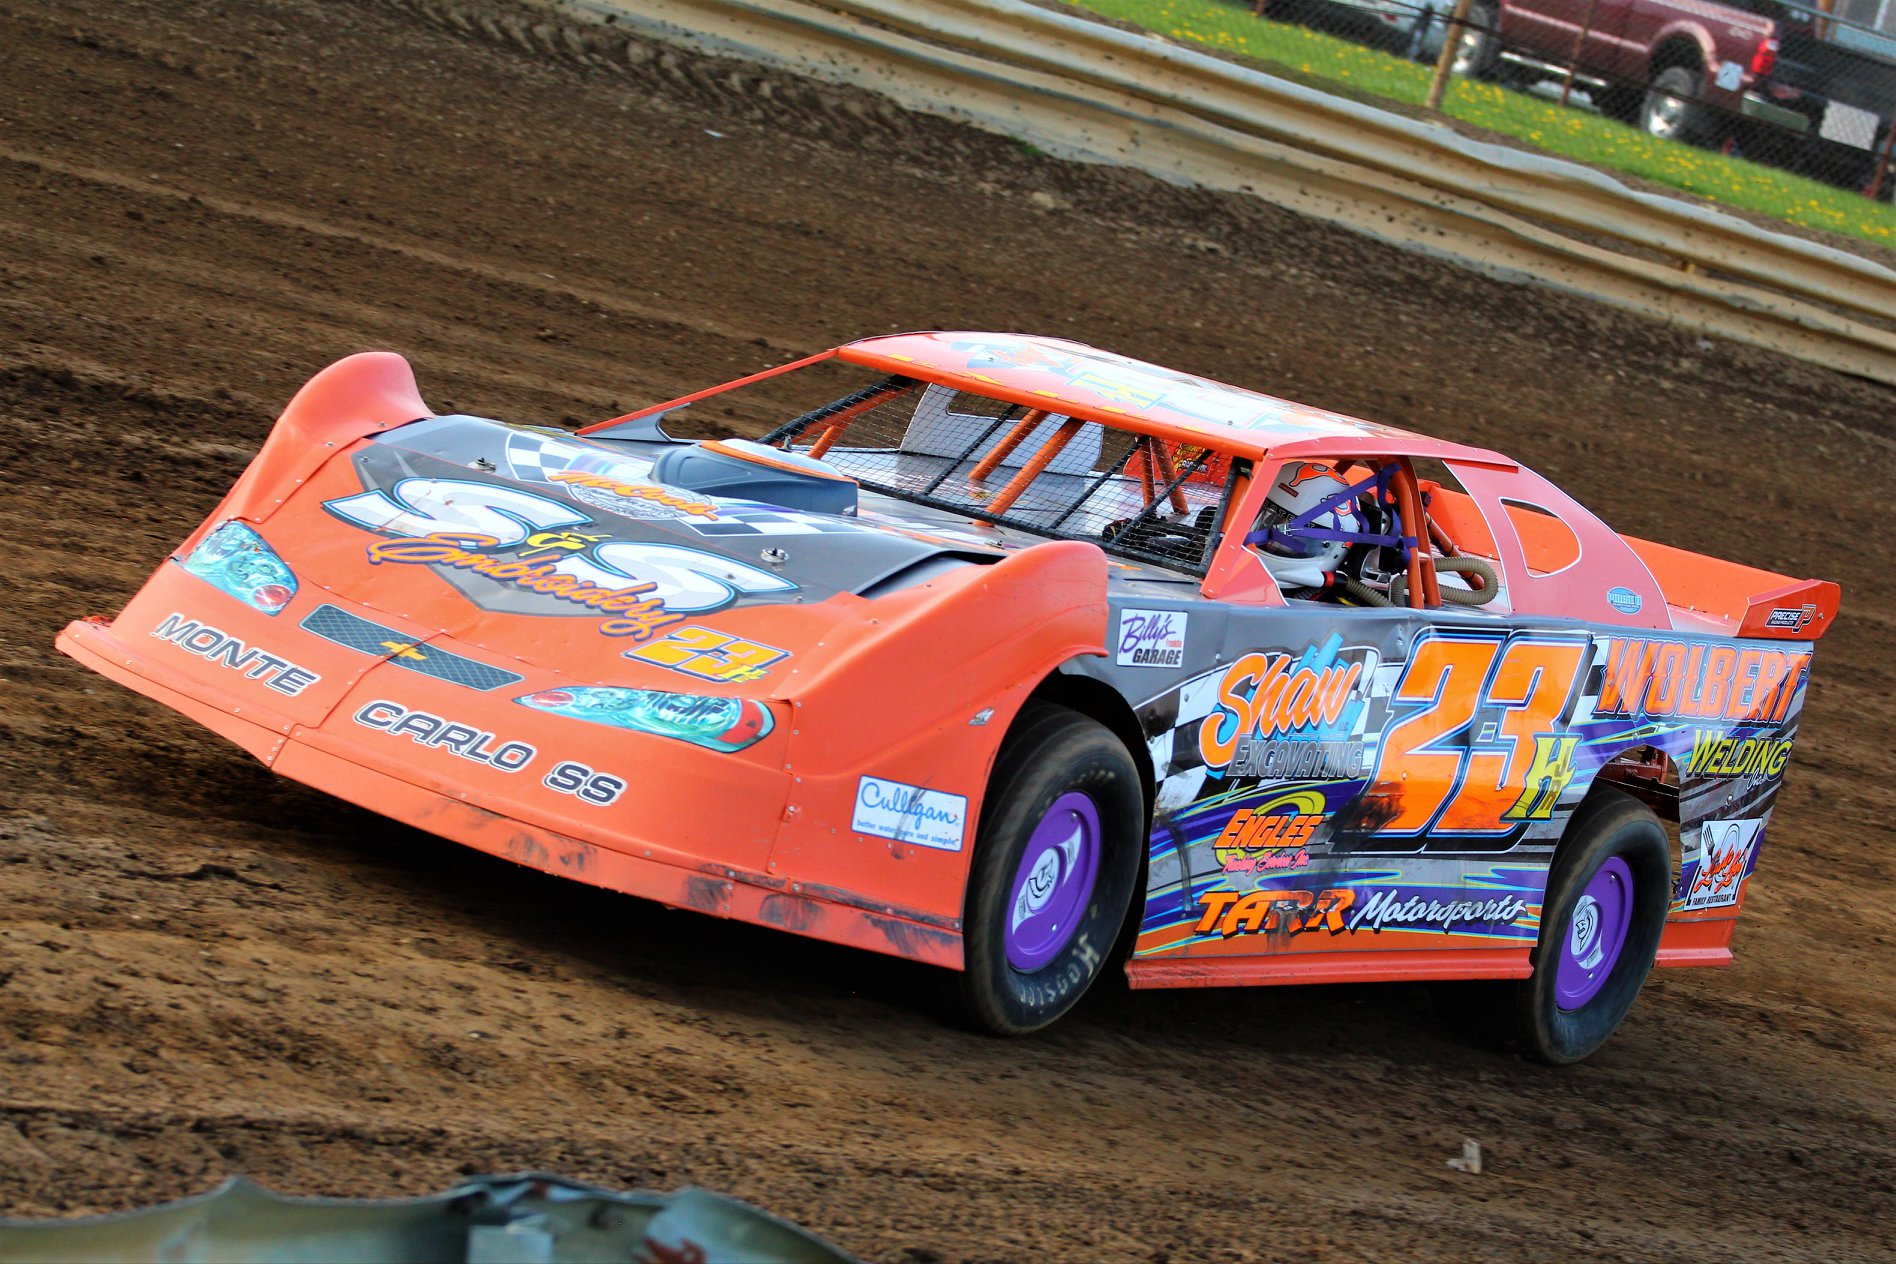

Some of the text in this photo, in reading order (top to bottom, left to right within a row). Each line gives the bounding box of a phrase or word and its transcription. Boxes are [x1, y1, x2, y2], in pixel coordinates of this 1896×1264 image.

[321, 477, 594, 550] S
[366, 532, 685, 641] Embroidery
[1119, 613, 1176, 654] Billy's
[1770, 611, 1801, 621] PRECISE
[150, 612, 322, 697] MONTE
[1132, 648, 1182, 665] GARAGE
[1593, 634, 1813, 726] WOLBERT
[1199, 652, 1362, 768] Shaw
[352, 700, 628, 806] CARLO SS
[1226, 734, 1364, 778] EXCAVATING
[1686, 730, 1794, 778] WELDING
[861, 782, 957, 830] Culligan
[1214, 808, 1324, 851] ENGLES
[1351, 889, 1526, 935] Motorsports
